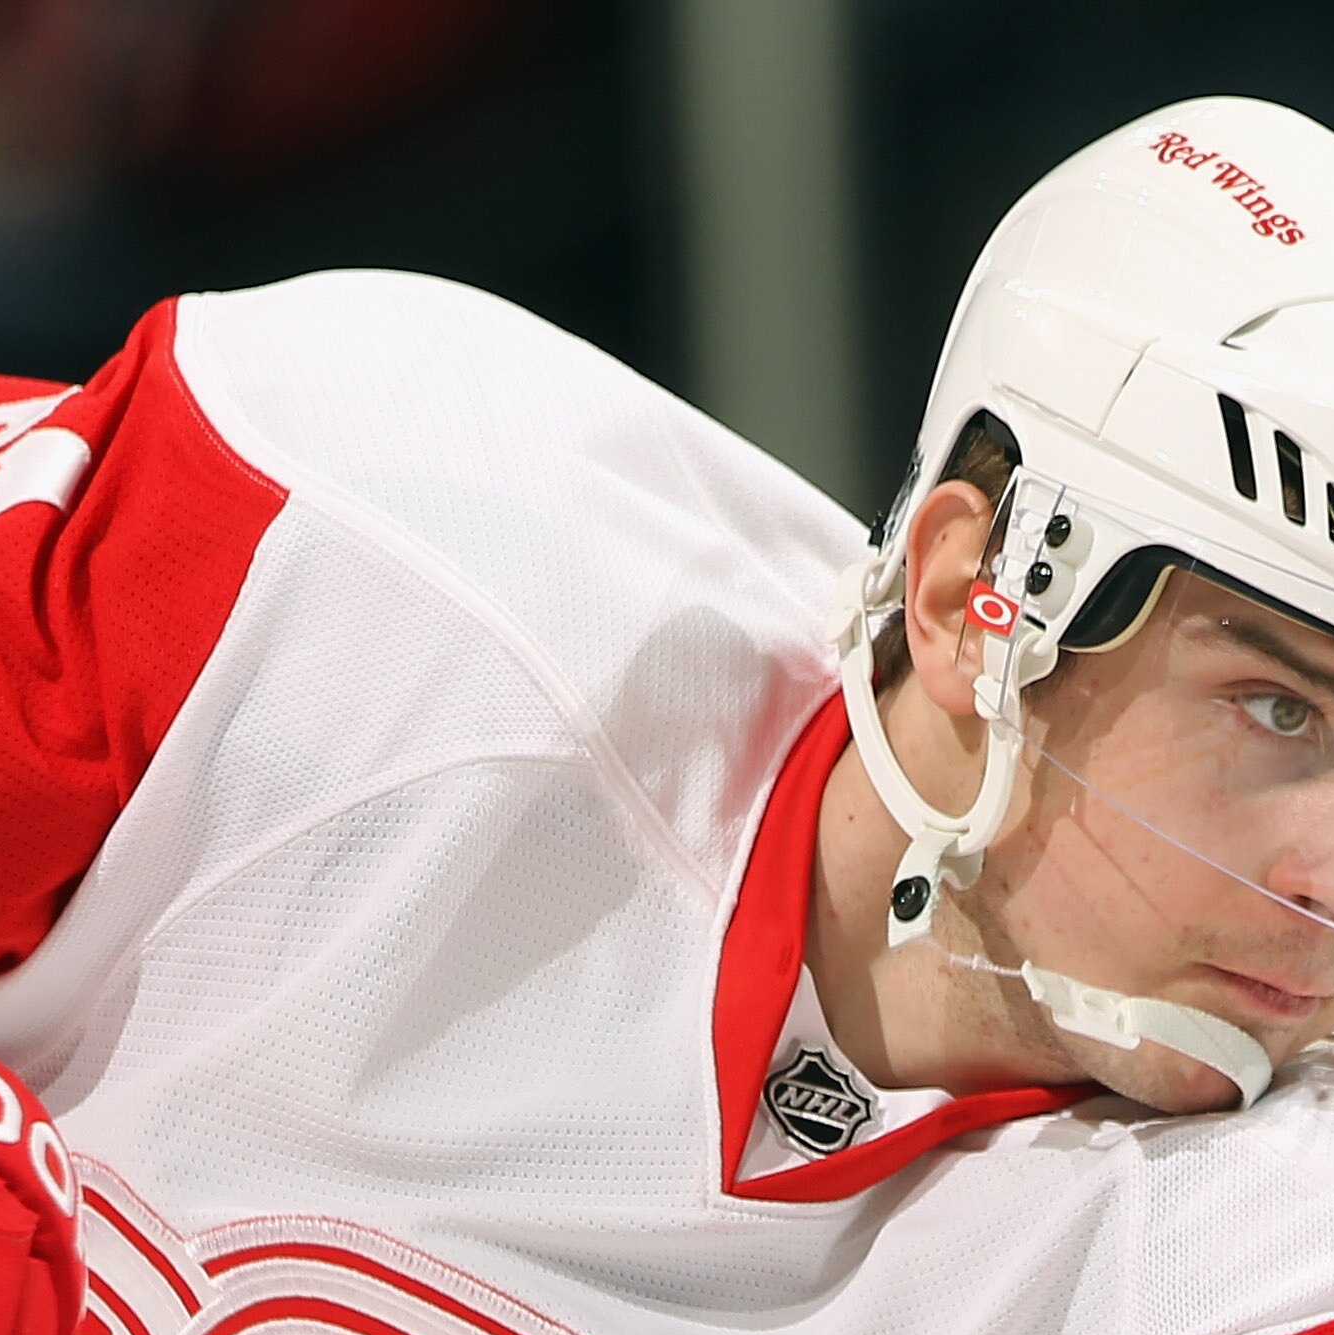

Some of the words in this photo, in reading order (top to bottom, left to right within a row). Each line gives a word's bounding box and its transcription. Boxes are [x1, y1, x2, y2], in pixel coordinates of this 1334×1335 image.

[1150, 132, 1219, 170] Red
[1212, 162, 1305, 245] Wings
[776, 1085, 859, 1122] NHL
